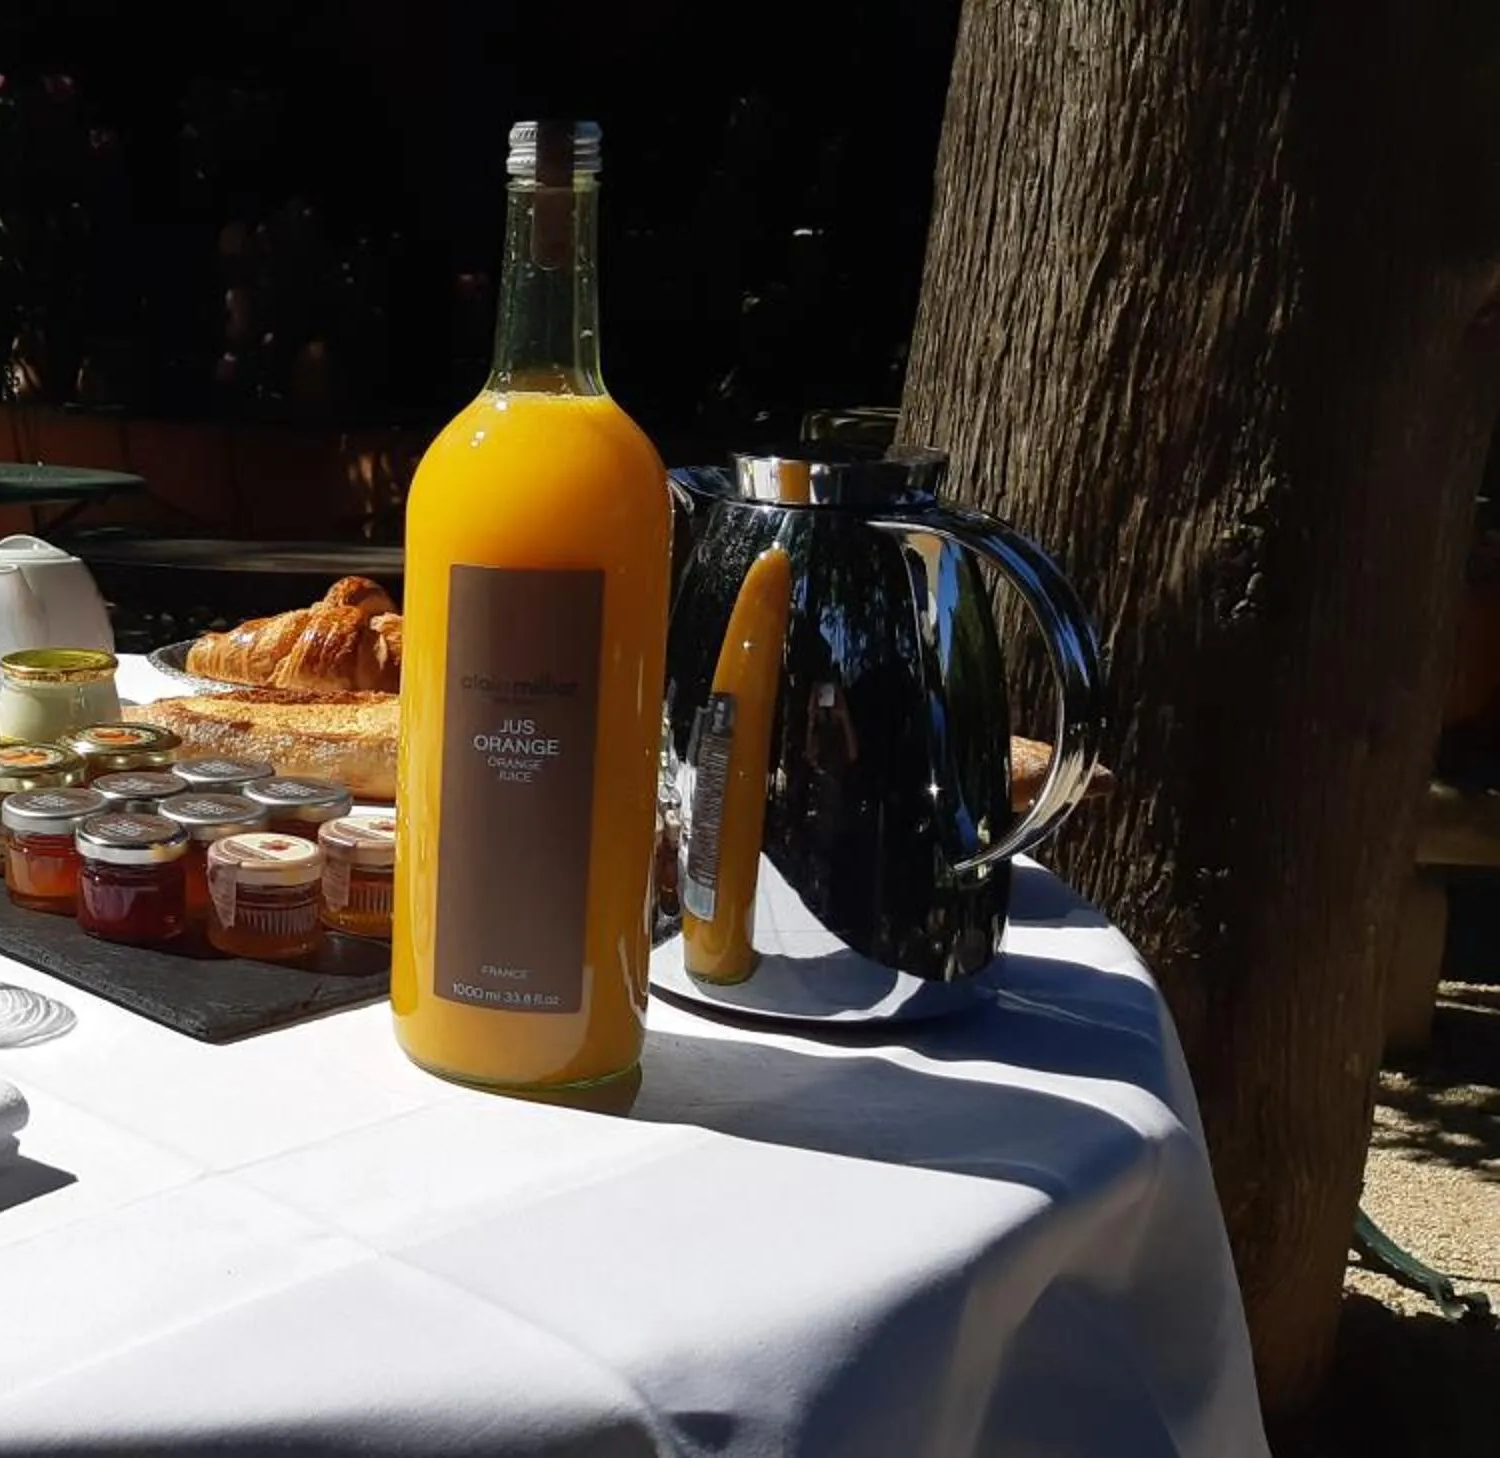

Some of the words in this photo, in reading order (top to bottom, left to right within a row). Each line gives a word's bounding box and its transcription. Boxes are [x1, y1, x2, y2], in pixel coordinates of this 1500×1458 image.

[499, 719, 536, 735] JUS
[473, 735, 560, 755] ORANGE
[487, 755, 543, 770] ORANGE
[499, 770, 533, 783] JUICE
[481, 964, 531, 979] FRANCE
[453, 982, 484, 998] 1000
[485, 990, 501, 1001] ml
